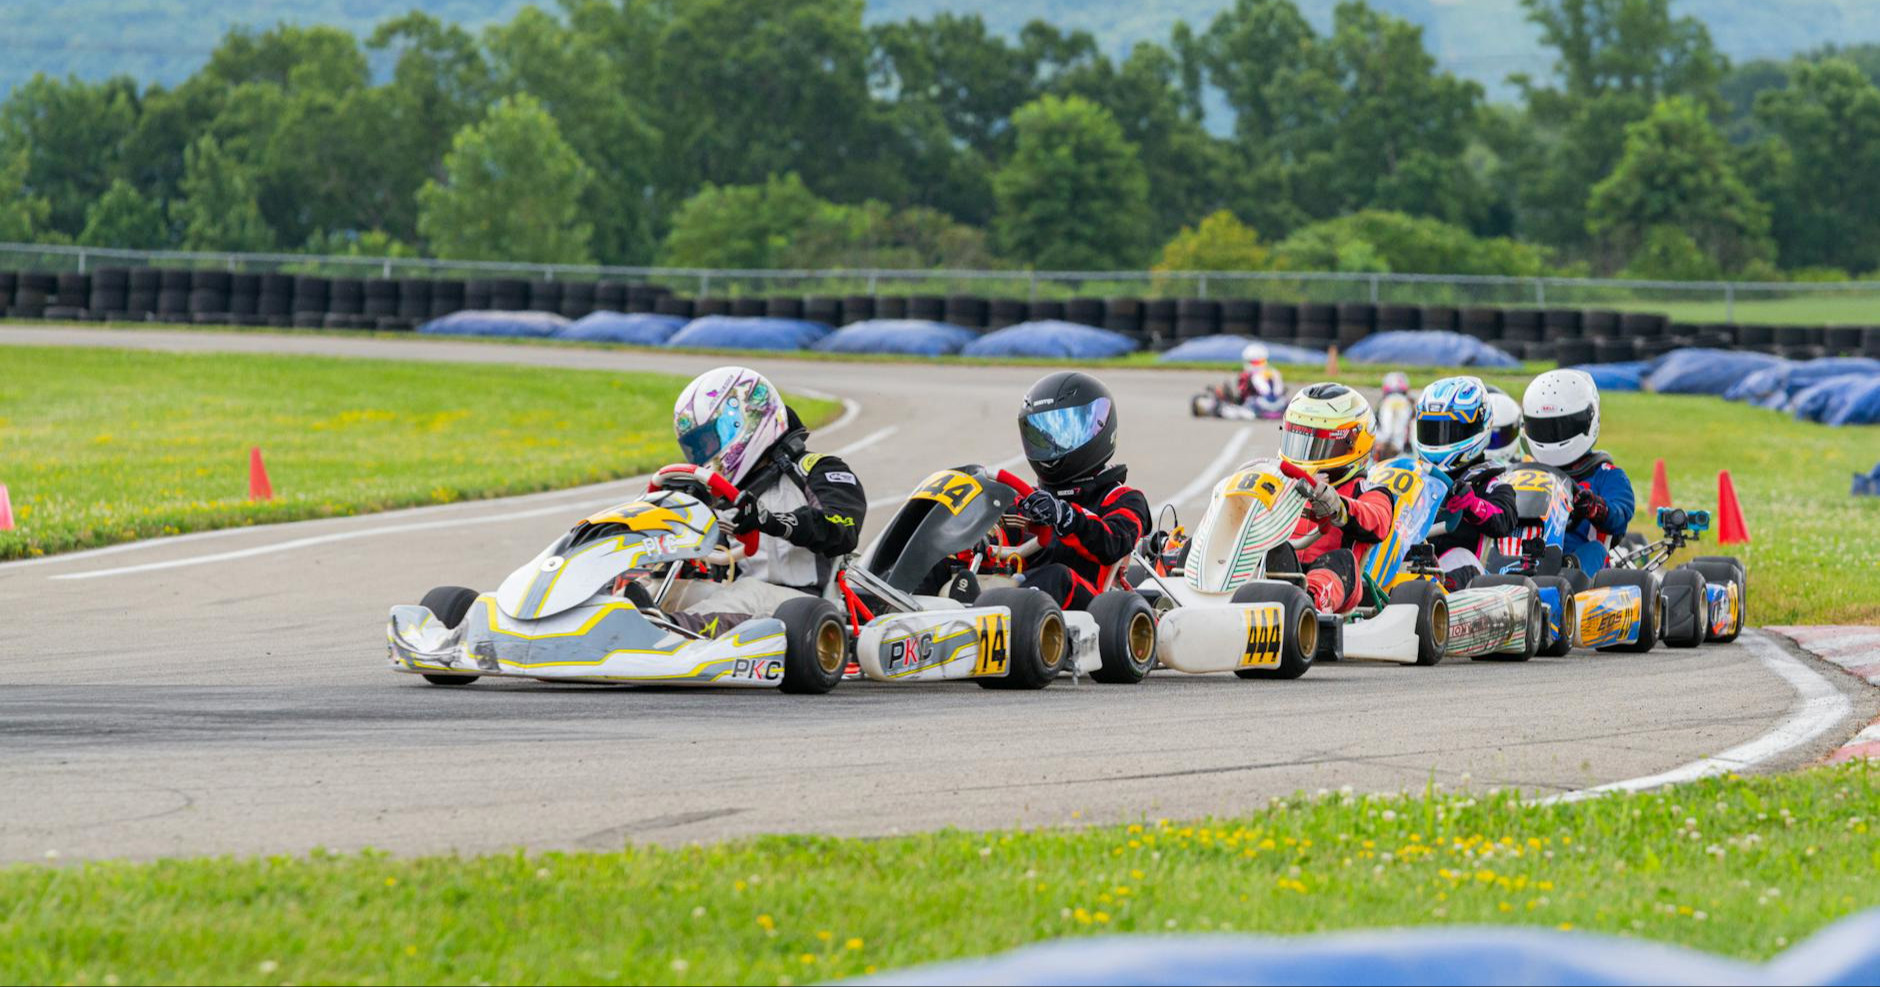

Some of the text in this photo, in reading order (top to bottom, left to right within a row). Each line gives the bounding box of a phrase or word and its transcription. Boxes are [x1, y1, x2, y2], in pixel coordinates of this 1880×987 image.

[641, 534, 678, 557] PKC
[889, 633, 932, 669] PKC
[979, 615, 1007, 672] 14
[1245, 609, 1280, 662] 444
[732, 658, 781, 680] PKC
